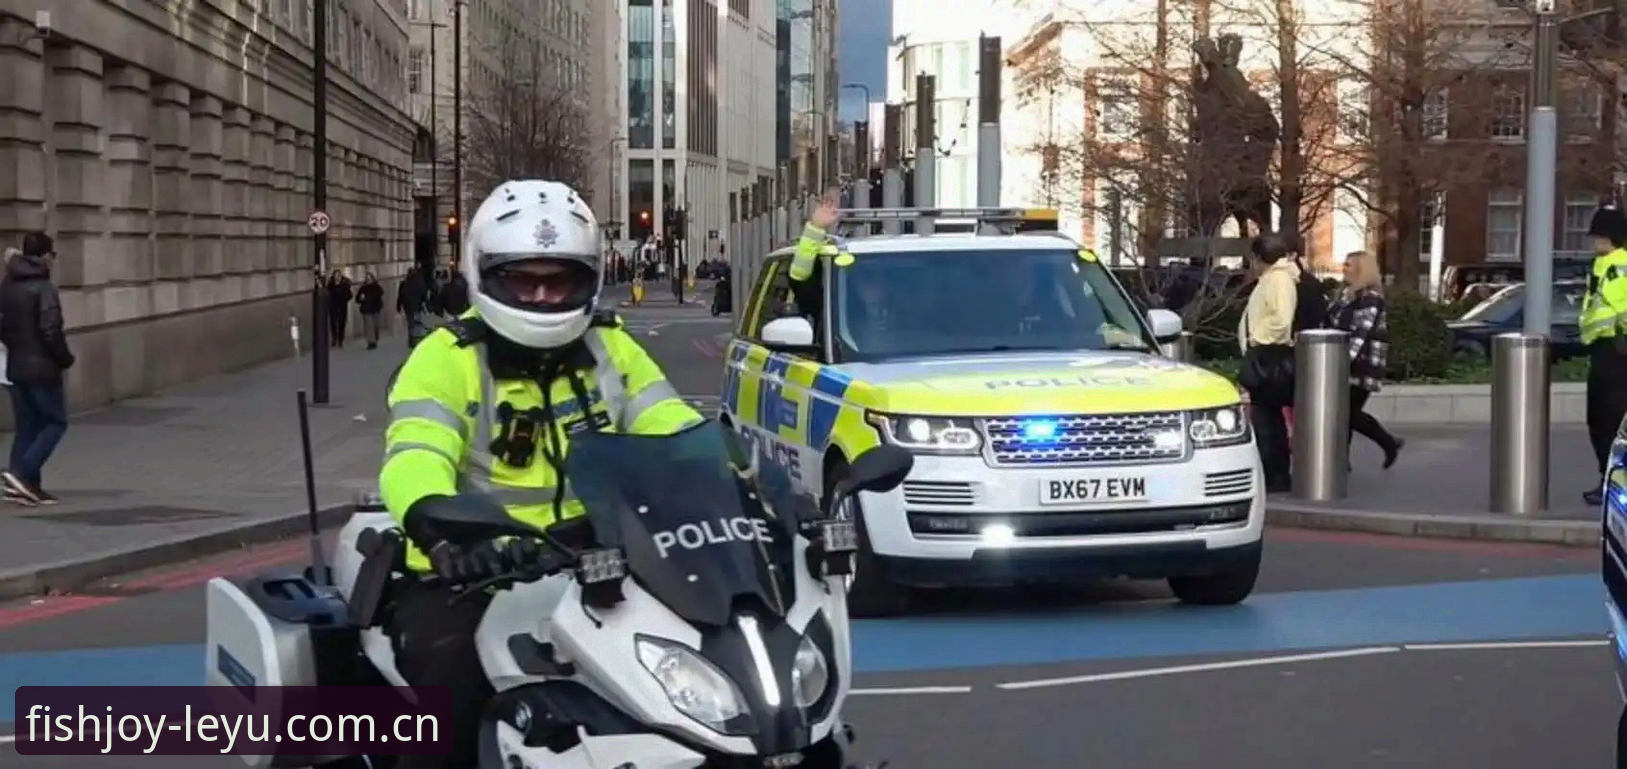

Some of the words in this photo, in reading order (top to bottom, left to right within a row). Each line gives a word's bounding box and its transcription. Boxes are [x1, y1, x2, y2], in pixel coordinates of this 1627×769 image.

[311, 215, 328, 228] 20
[985, 376, 1153, 389] POLICE
[1050, 479, 1100, 499] BX67
[1107, 477, 1145, 497] EVM
[653, 517, 774, 558] POLICE
